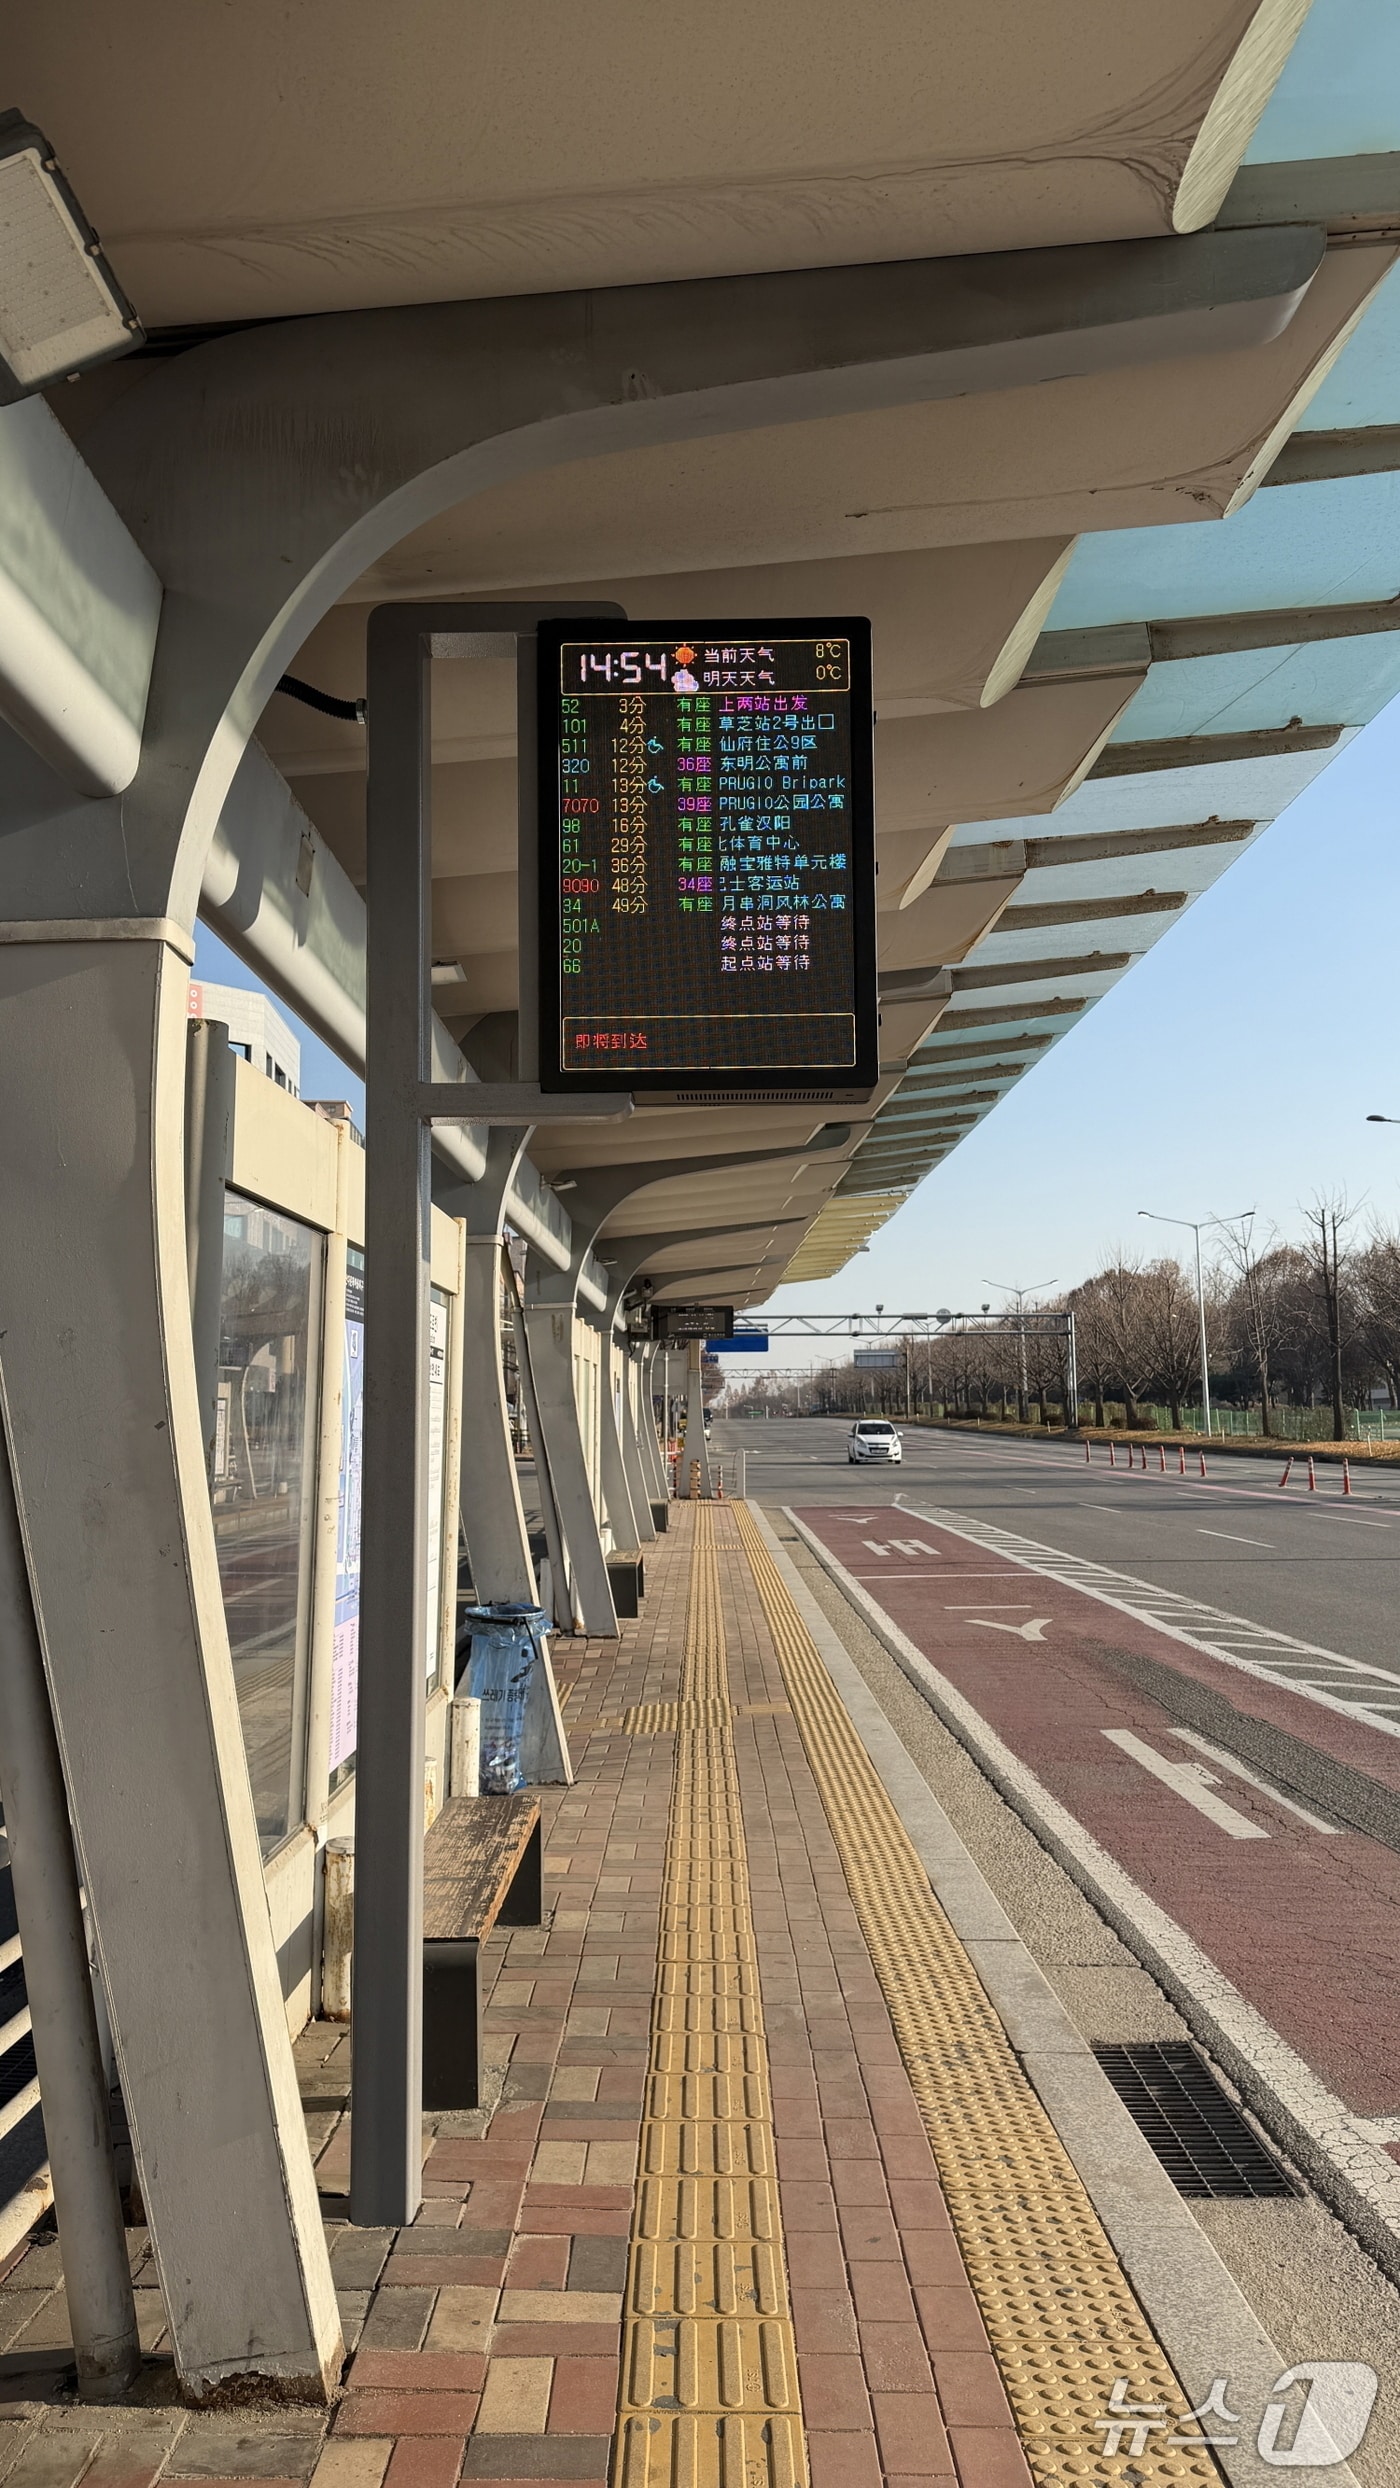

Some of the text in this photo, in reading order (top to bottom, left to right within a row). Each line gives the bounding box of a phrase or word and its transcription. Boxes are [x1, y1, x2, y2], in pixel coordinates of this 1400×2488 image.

[703, 647, 775, 663] 当前天气
[580, 652, 667, 683] 14:54
[703, 670, 775, 687] 明天天气
[562, 694, 809, 715] 52 3分 有座 上两站出发
[563, 719, 586, 734] 101
[619, 716, 647, 735] 4分
[676, 717, 711, 733] 有座
[562, 735, 818, 754] 511 12分 有座 仙府住公9区
[562, 755, 808, 774] 320 12分 36座 东明公寓前
[563, 775, 847, 794] 11 13分 有座 PRUGIO Bripark
[562, 794, 845, 814] 7070 13分 39座 PRUGIO公园公寓
[562, 815, 791, 834] 98 16分 有座 孔雀汉阳
[562, 839, 578, 853] 61
[611, 836, 648, 854] 29分
[678, 837, 713, 852] 有座
[562, 859, 597, 874] 20-1
[611, 856, 648, 874] 36分
[678, 857, 713, 872] 有座
[562, 879, 600, 894] 9090
[611, 876, 649, 894] 48分
[678, 876, 713, 892] 34座
[562, 899, 581, 914] 34
[611, 896, 649, 914] 49分
[678, 896, 713, 912] 有座
[562, 915, 810, 934] 501A 终点站等待
[562, 935, 810, 954] 20 终点站等待
[563, 955, 811, 974] 66 起点站等待
[574, 1032, 649, 1050] 即将到达
[482, 1688, 506, 1702] 쓰레기
